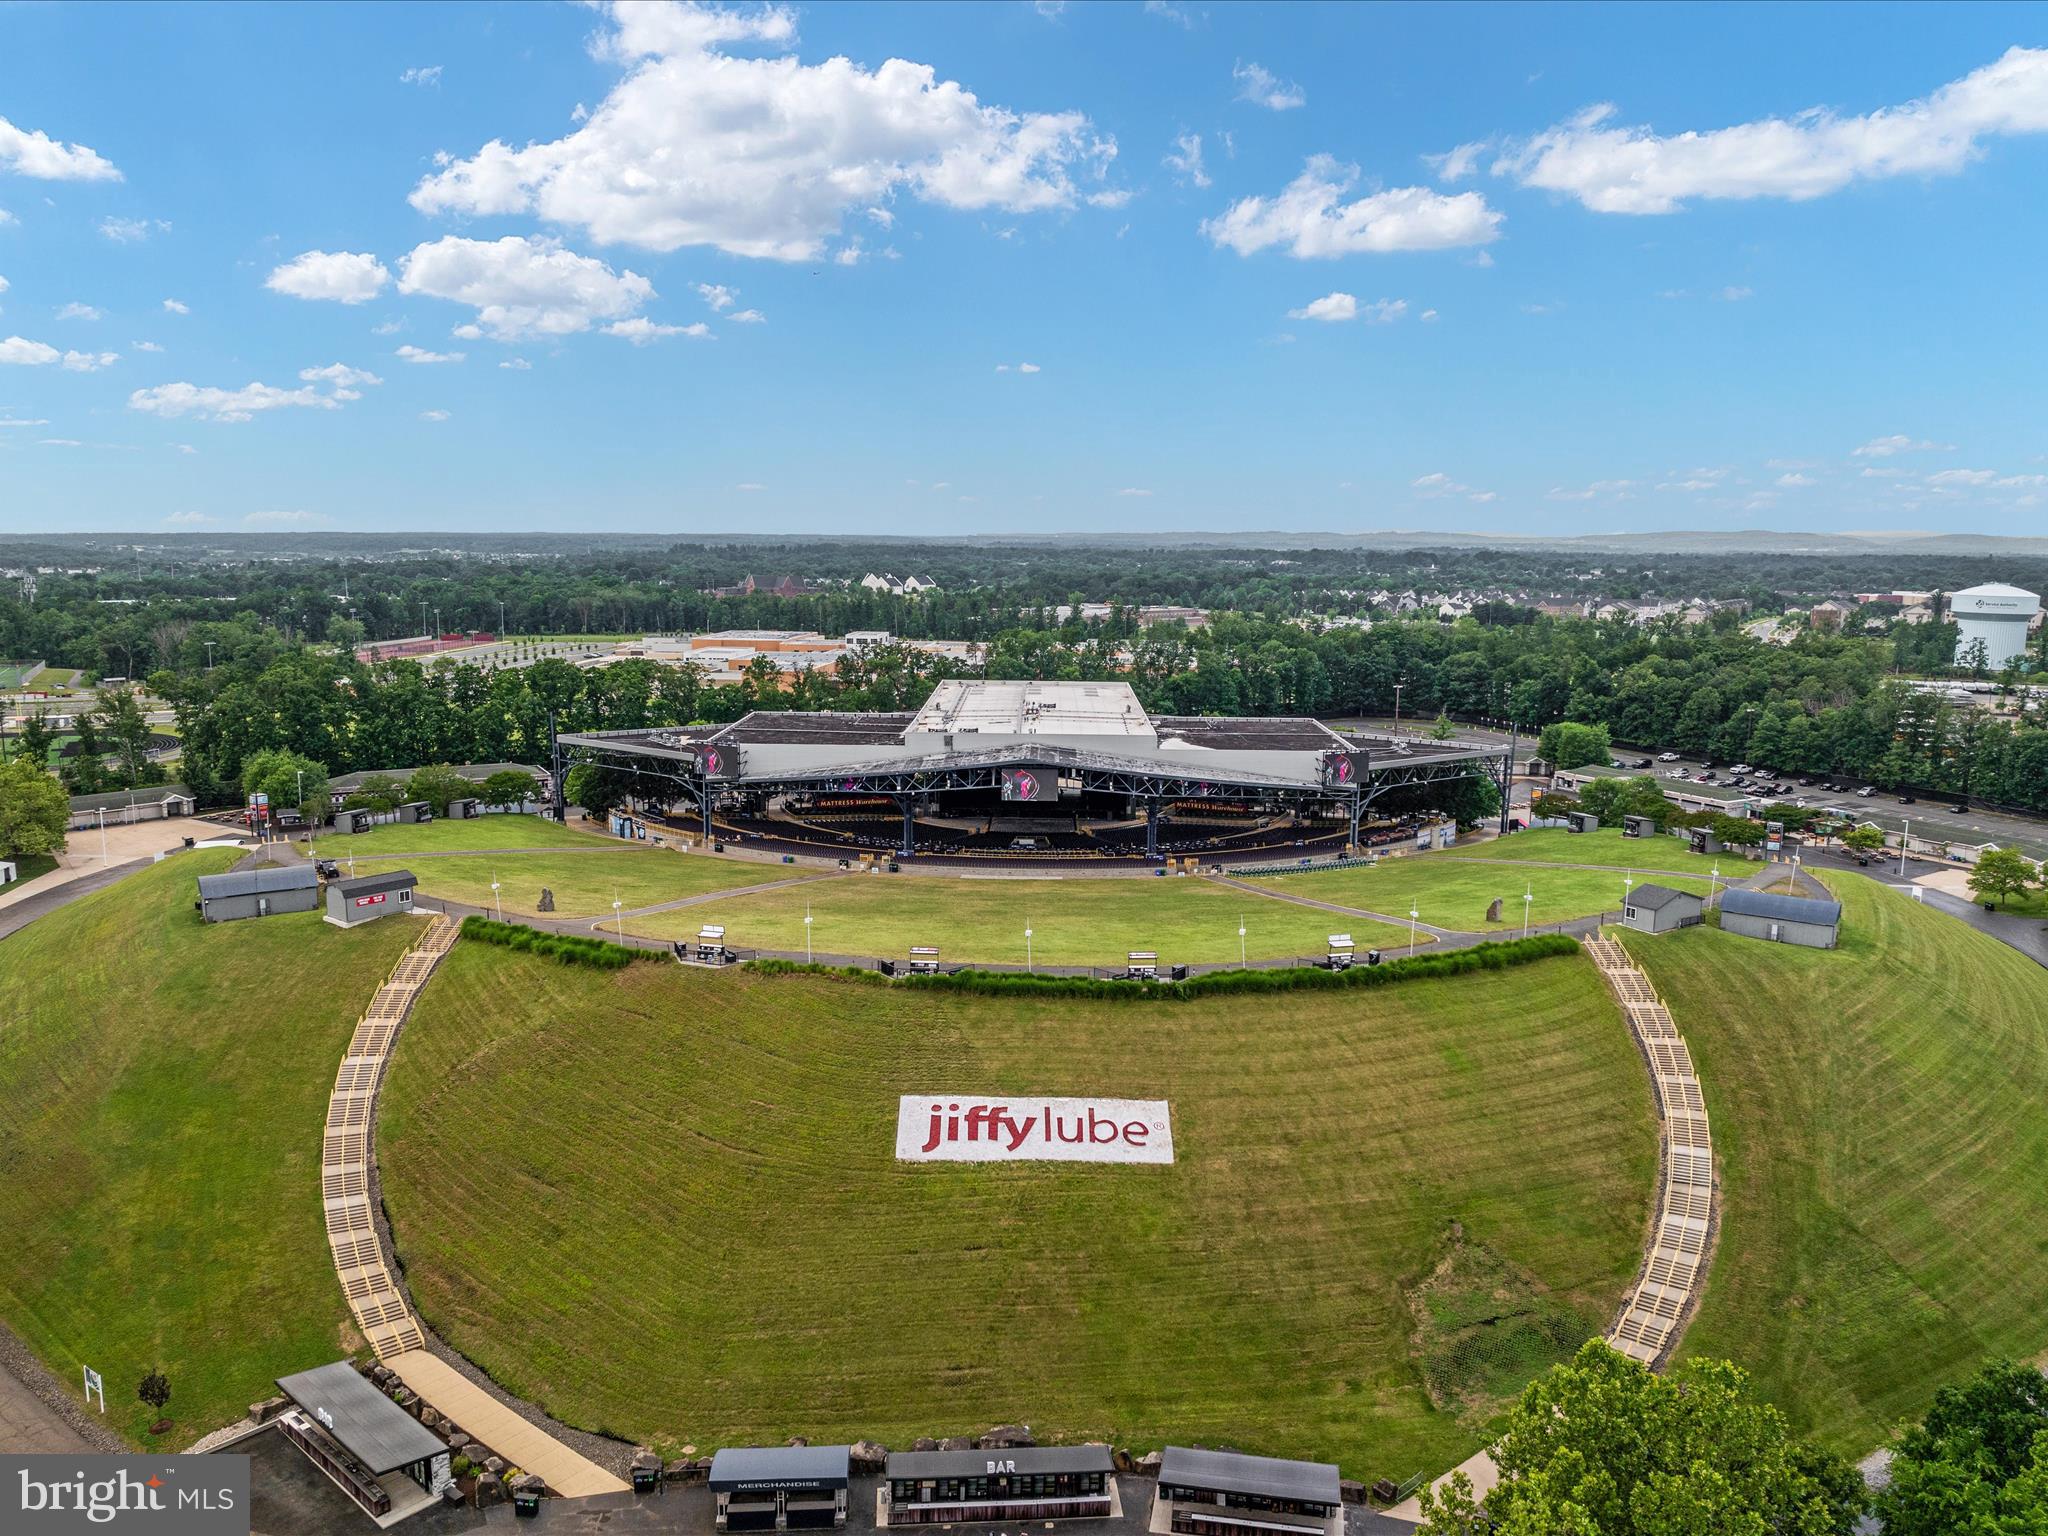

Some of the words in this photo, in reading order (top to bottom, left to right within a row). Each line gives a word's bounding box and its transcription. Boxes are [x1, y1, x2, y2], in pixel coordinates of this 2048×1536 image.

[1176, 802, 1210, 810] MATTRESS
[986, 1460, 1016, 1474] BAR
[737, 1481, 820, 1489] MERCHANDISE
